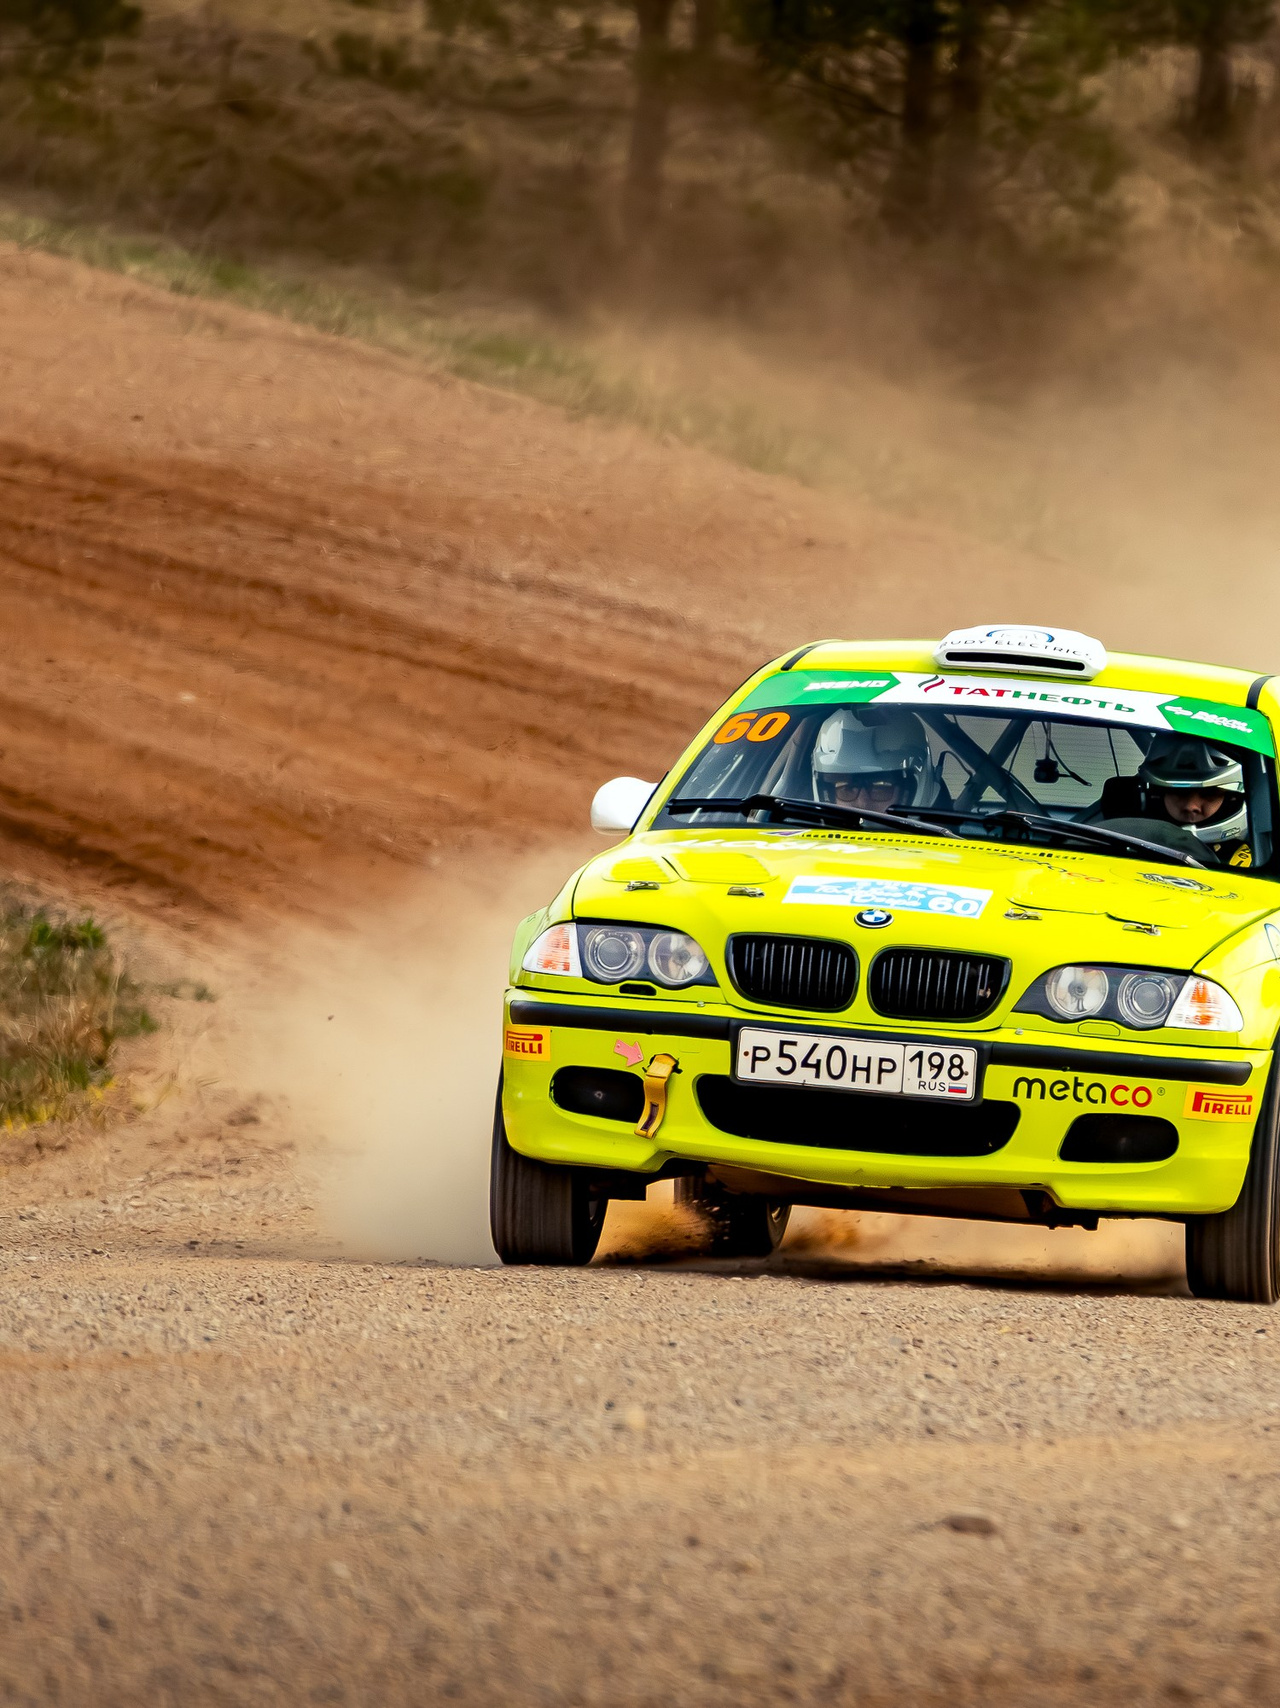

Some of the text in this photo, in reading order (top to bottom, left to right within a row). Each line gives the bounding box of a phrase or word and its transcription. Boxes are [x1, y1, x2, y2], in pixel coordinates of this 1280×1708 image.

[948, 686, 1136, 713] ТАТНЕФТЬ
[713, 711, 791, 745] 60
[927, 896, 979, 916] 60
[505, 1030, 543, 1055] PIRELLI
[908, 1050, 965, 1082] 198
[918, 1080, 946, 1092] RUS
[1012, 1076, 1153, 1108] metaco
[1191, 1091, 1253, 1116] PIRELLI
